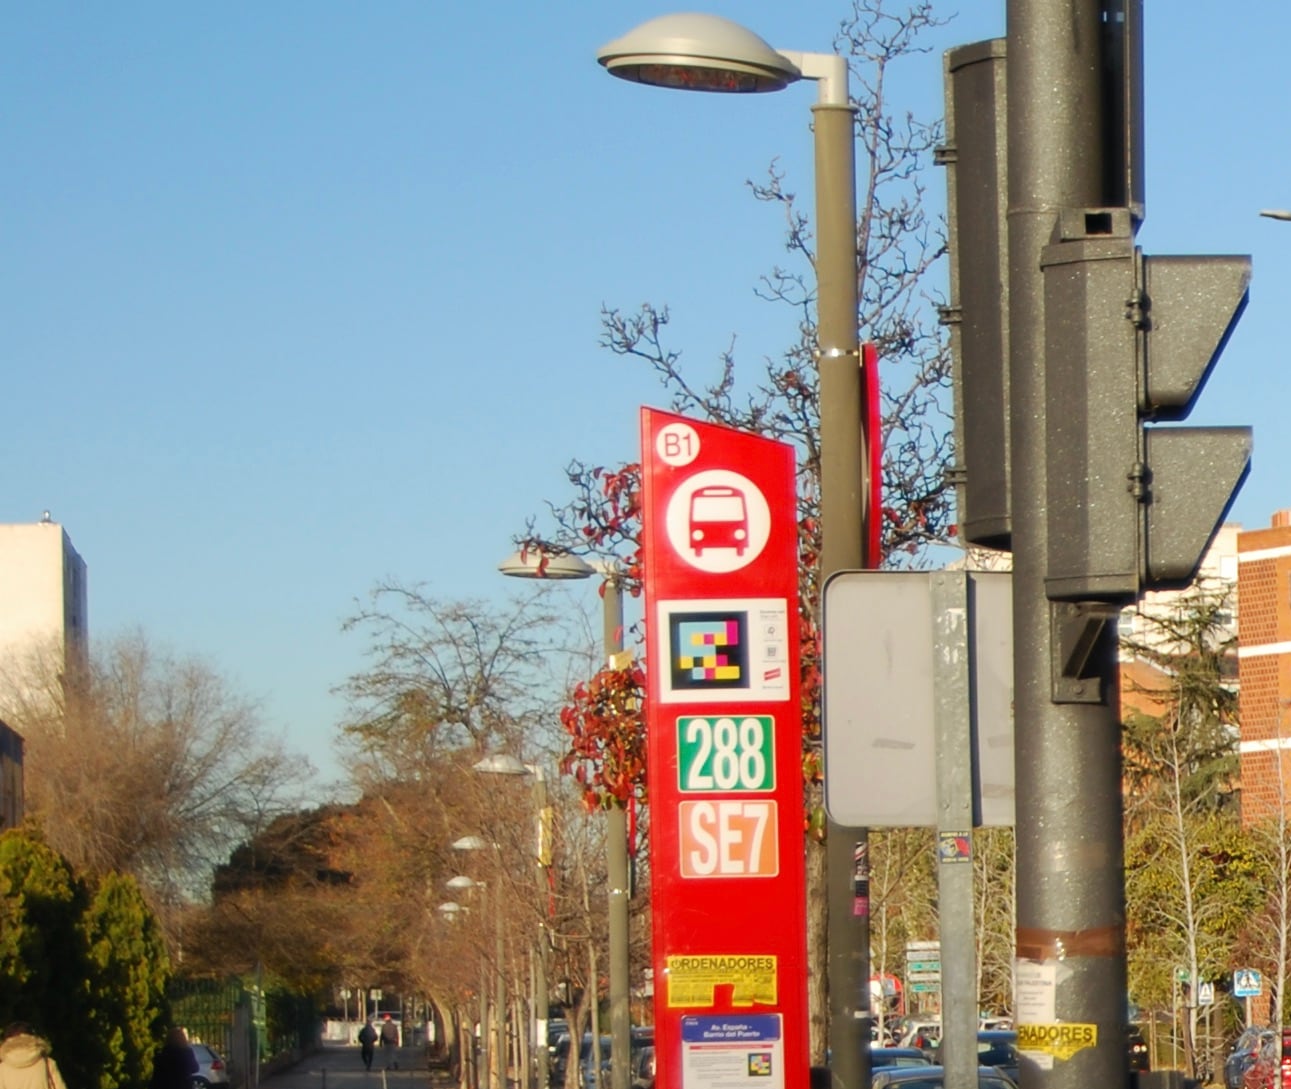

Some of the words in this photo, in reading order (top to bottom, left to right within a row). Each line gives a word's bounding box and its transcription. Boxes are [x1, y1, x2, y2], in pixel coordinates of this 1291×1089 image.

[664, 432, 692, 457] B1
[686, 717, 766, 790] 288
[690, 802, 769, 875] SE7
